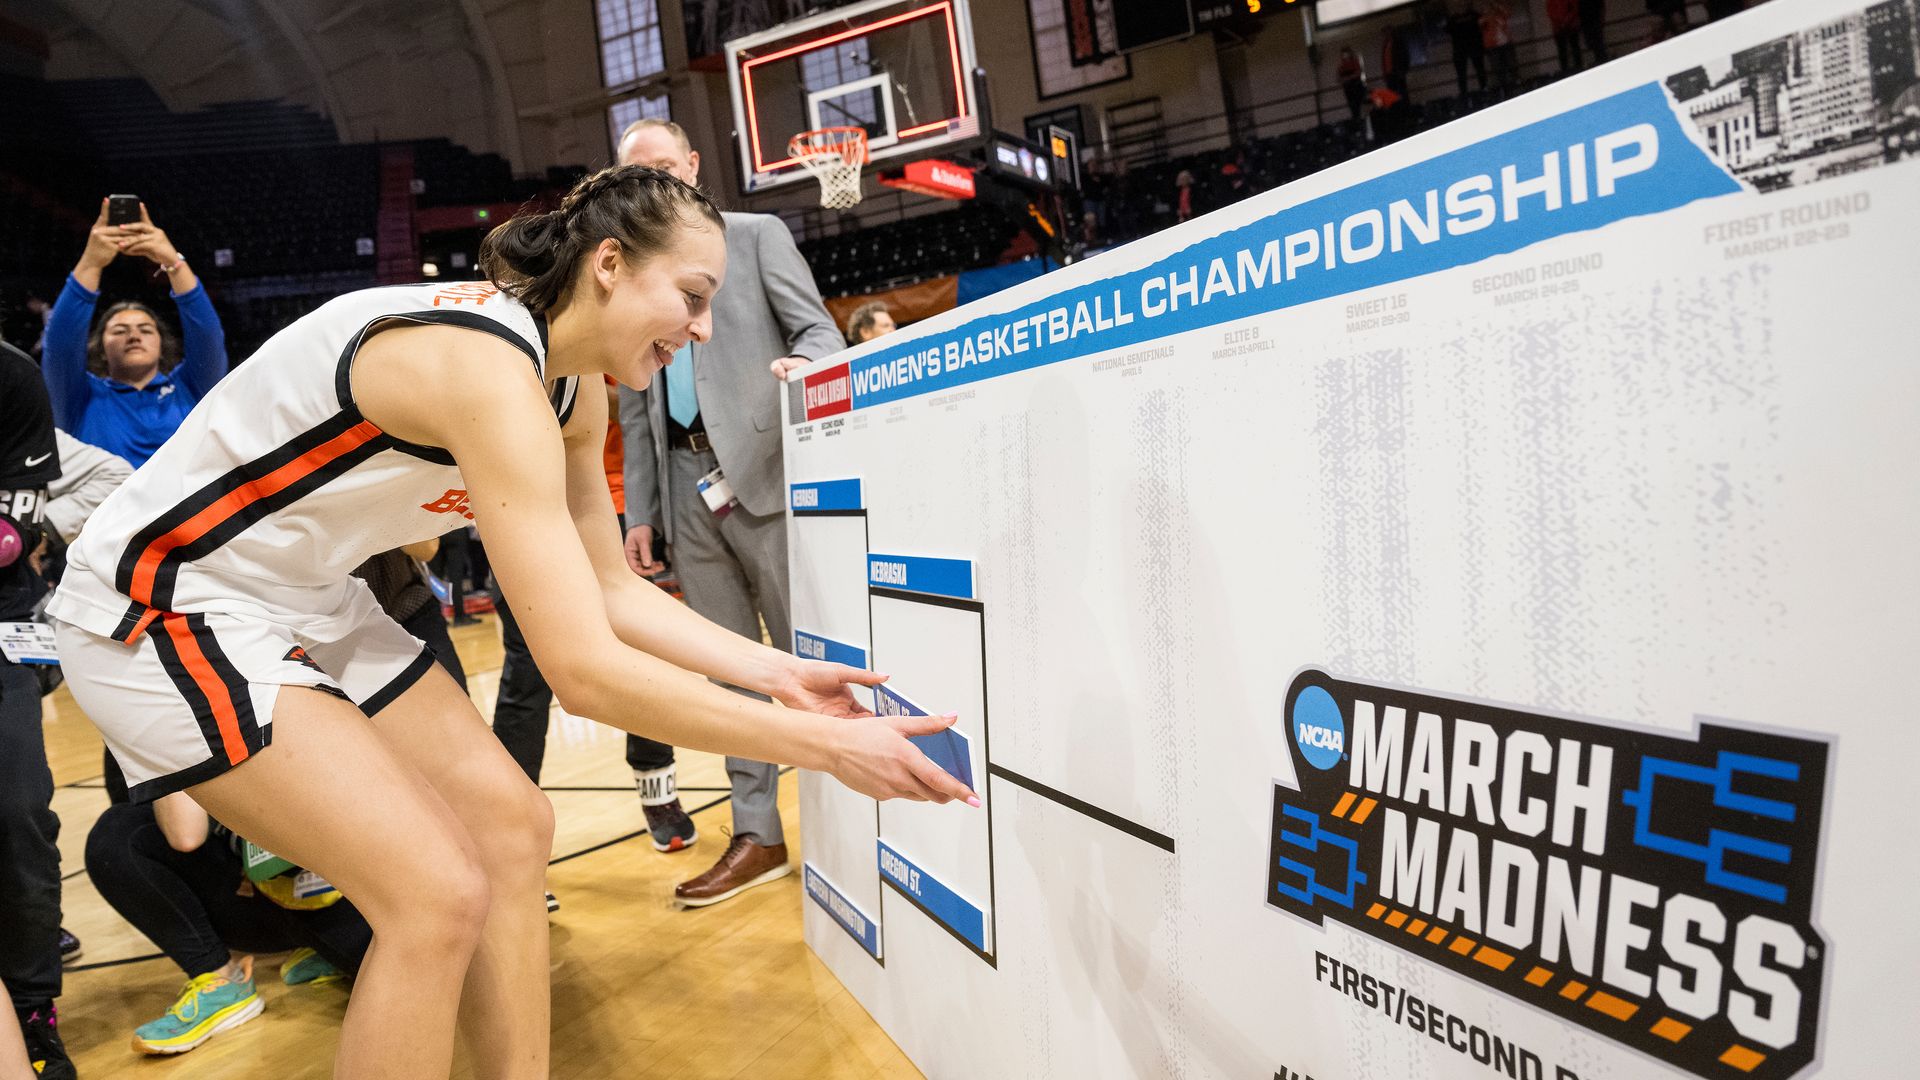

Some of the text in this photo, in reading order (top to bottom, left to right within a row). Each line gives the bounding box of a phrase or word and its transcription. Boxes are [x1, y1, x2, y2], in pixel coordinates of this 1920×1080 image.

[1703, 191, 1871, 245] FIRST ROUND
[853, 347, 941, 396] WOMEN'S
[945, 289, 1134, 373] BASKETBALL
[1140, 122, 1659, 318] CHAMPIONSHIP
[1724, 235, 1789, 260] MARCH
[1472, 252, 1603, 295] SECOND ROUND
[1346, 293, 1408, 319] SWEET 16
[1494, 279, 1580, 307] MARCH 24-25
[1224, 326, 1260, 345] ELITE 8
[1346, 311, 1410, 334] MARCH 29-30
[1092, 345, 1175, 373] NATIONAL SEMIFINALS
[1212, 345, 1237, 361] MARCH
[870, 560, 907, 586] NEBRASKA
[1299, 722, 1344, 753] NCAA
[1349, 699, 1614, 856] MARCH
[880, 848, 922, 897] OREGON ST.
[1379, 807, 1806, 1050] MADNESS
[1315, 950, 1543, 1080] FIRST/SECOND
